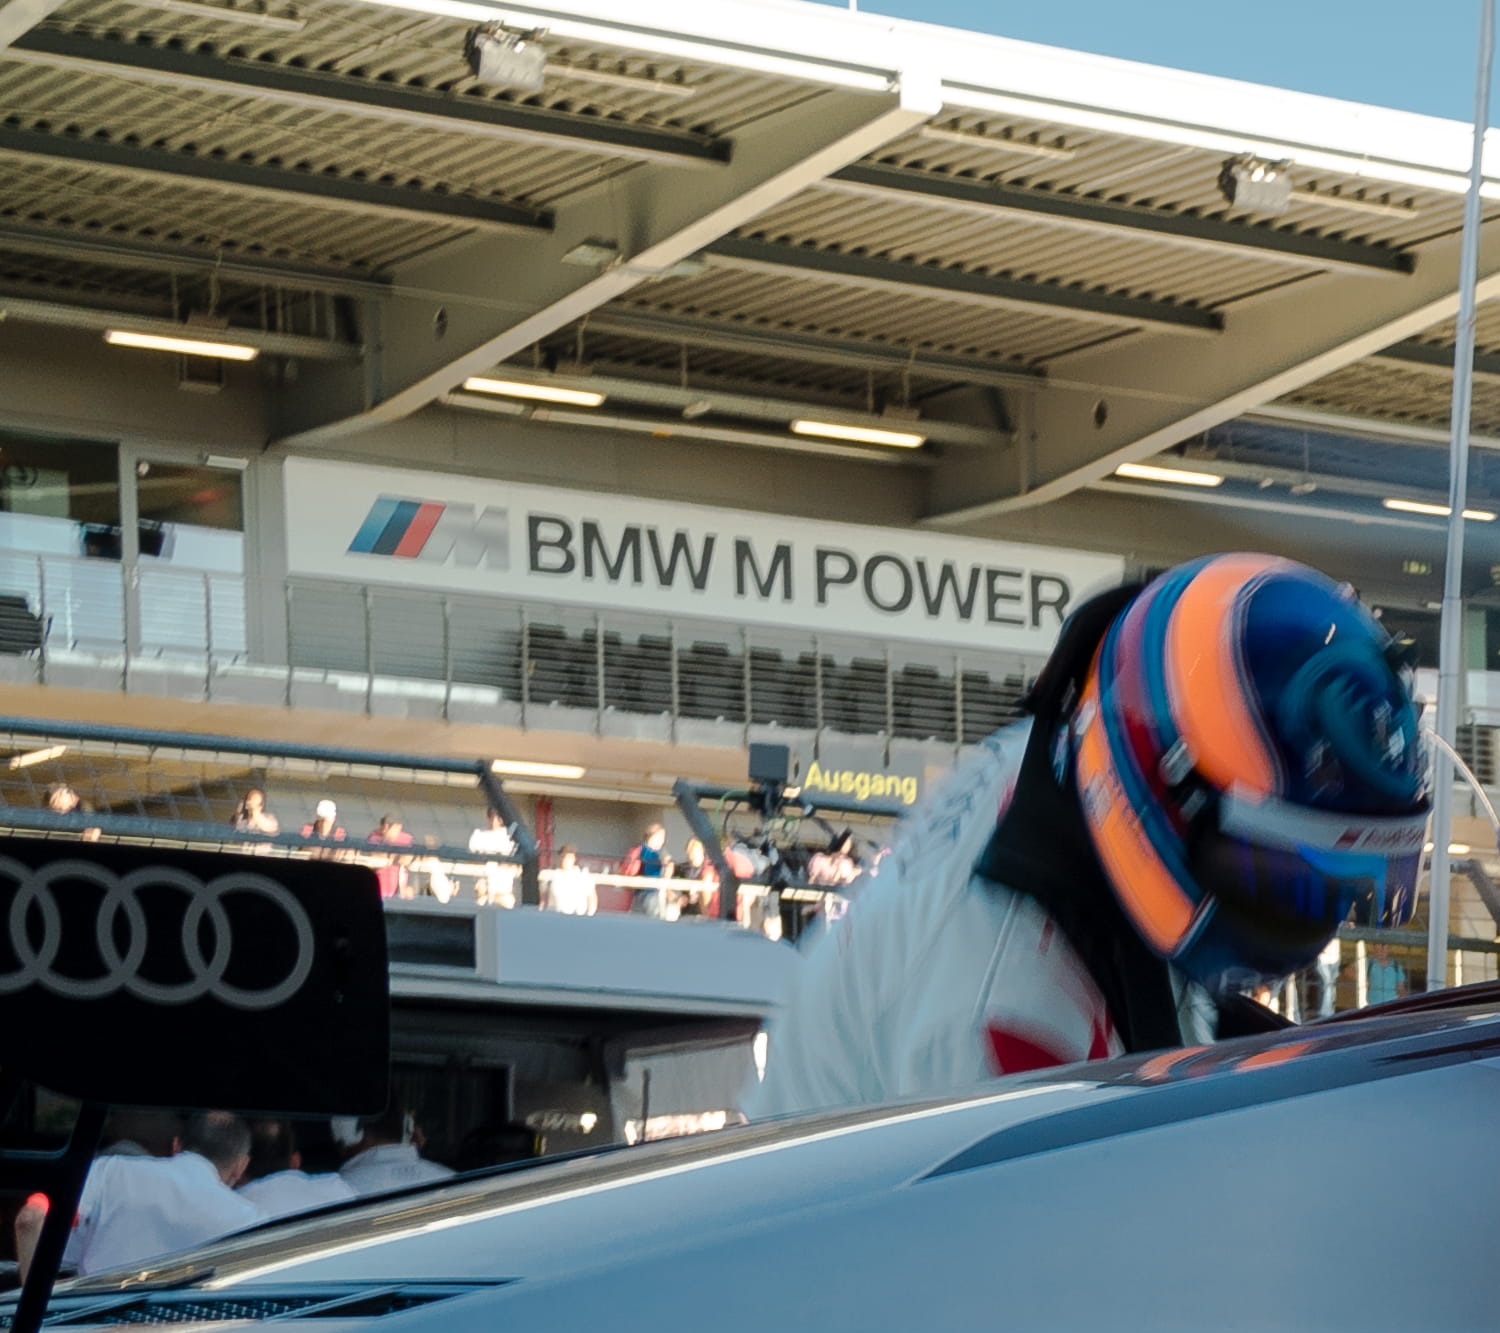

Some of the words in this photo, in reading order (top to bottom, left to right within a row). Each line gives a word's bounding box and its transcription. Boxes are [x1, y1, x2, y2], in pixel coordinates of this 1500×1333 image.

[527, 512, 718, 592] BMW
[734, 539, 794, 602] M
[815, 547, 1071, 628] POWER
[803, 761, 918, 805] Ausgang
